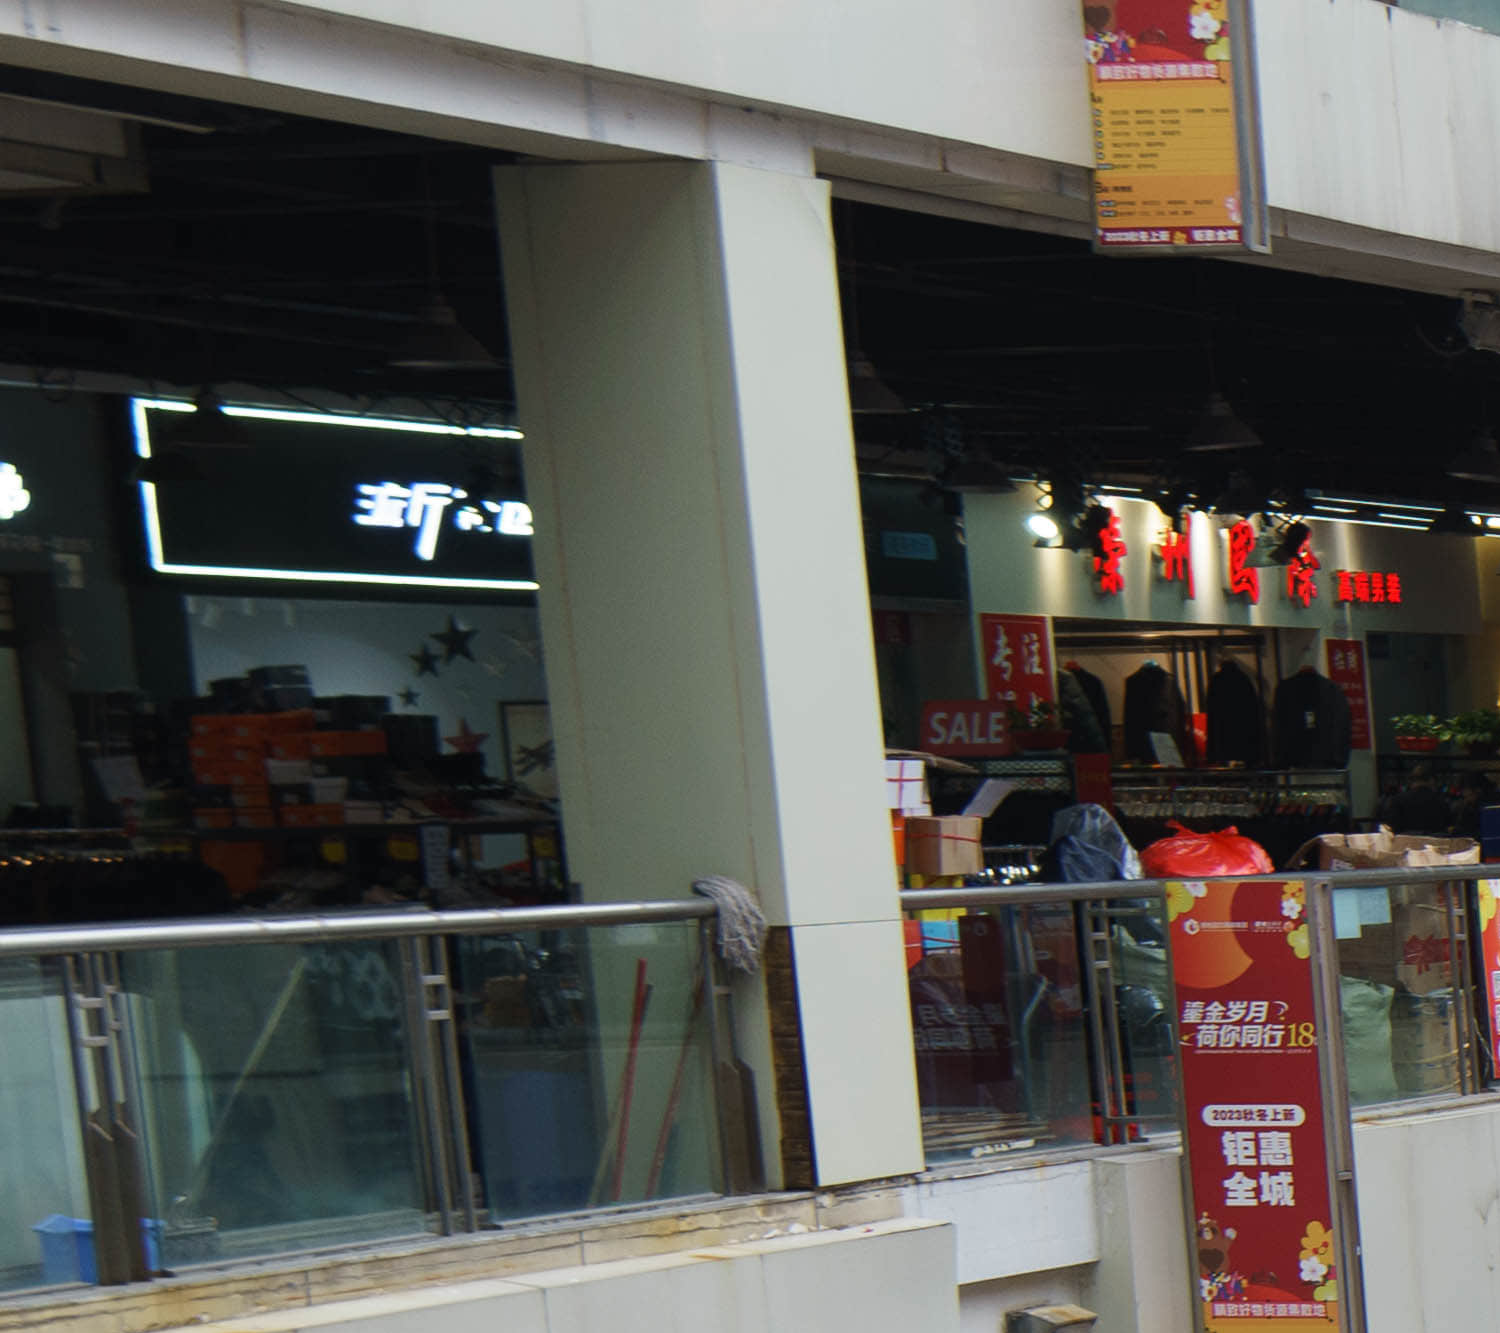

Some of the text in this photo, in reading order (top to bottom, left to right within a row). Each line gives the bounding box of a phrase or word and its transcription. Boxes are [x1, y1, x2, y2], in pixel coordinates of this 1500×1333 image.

[928, 709, 1005, 746] SALE
[1211, 1108, 1296, 1122] 2023秋冬上新
[1221, 1130, 1294, 1166] 钜惠
[1223, 1171, 1296, 1206] 全城
